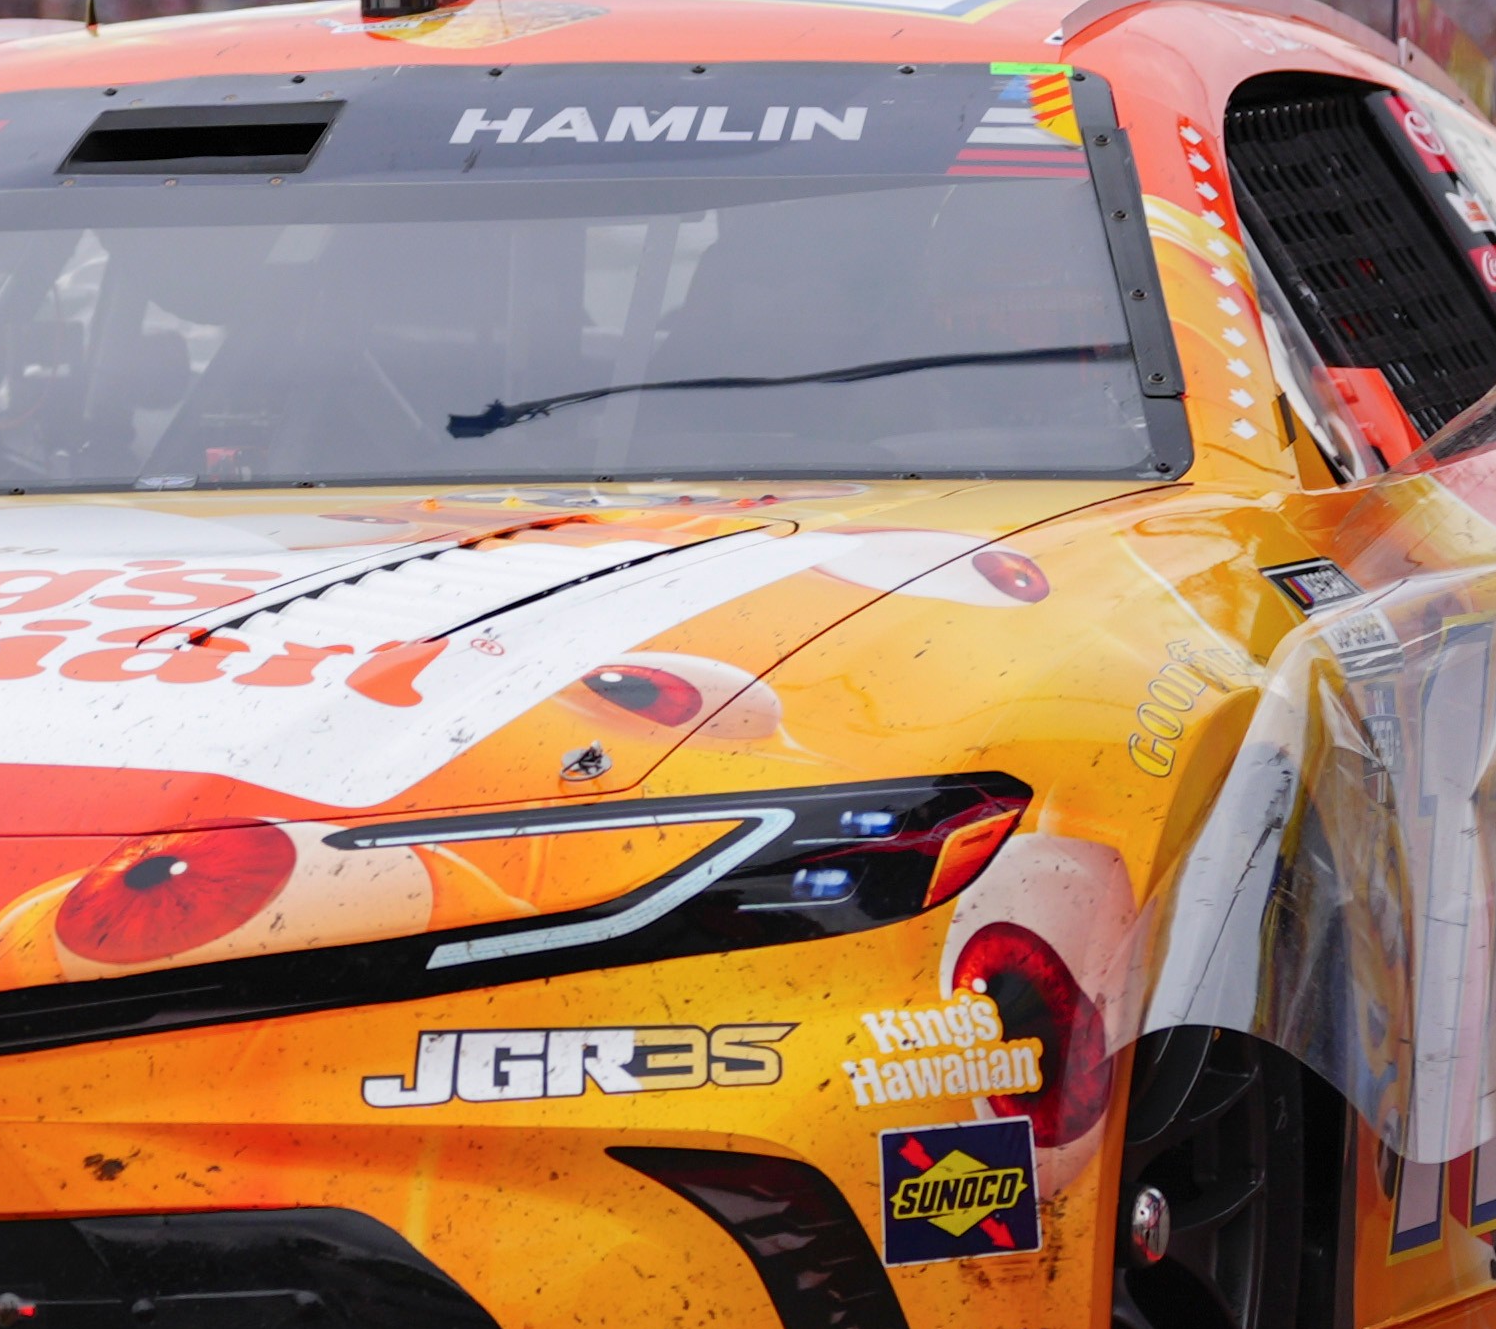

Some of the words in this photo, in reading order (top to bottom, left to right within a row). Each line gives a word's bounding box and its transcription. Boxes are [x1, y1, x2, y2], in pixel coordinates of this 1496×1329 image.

[449, 106, 868, 144] HAMLIN
[862, 995, 999, 1054] King's
[842, 1046, 1039, 1106] Hawaiian
[897, 1172, 1019, 1215] SUNOCO
